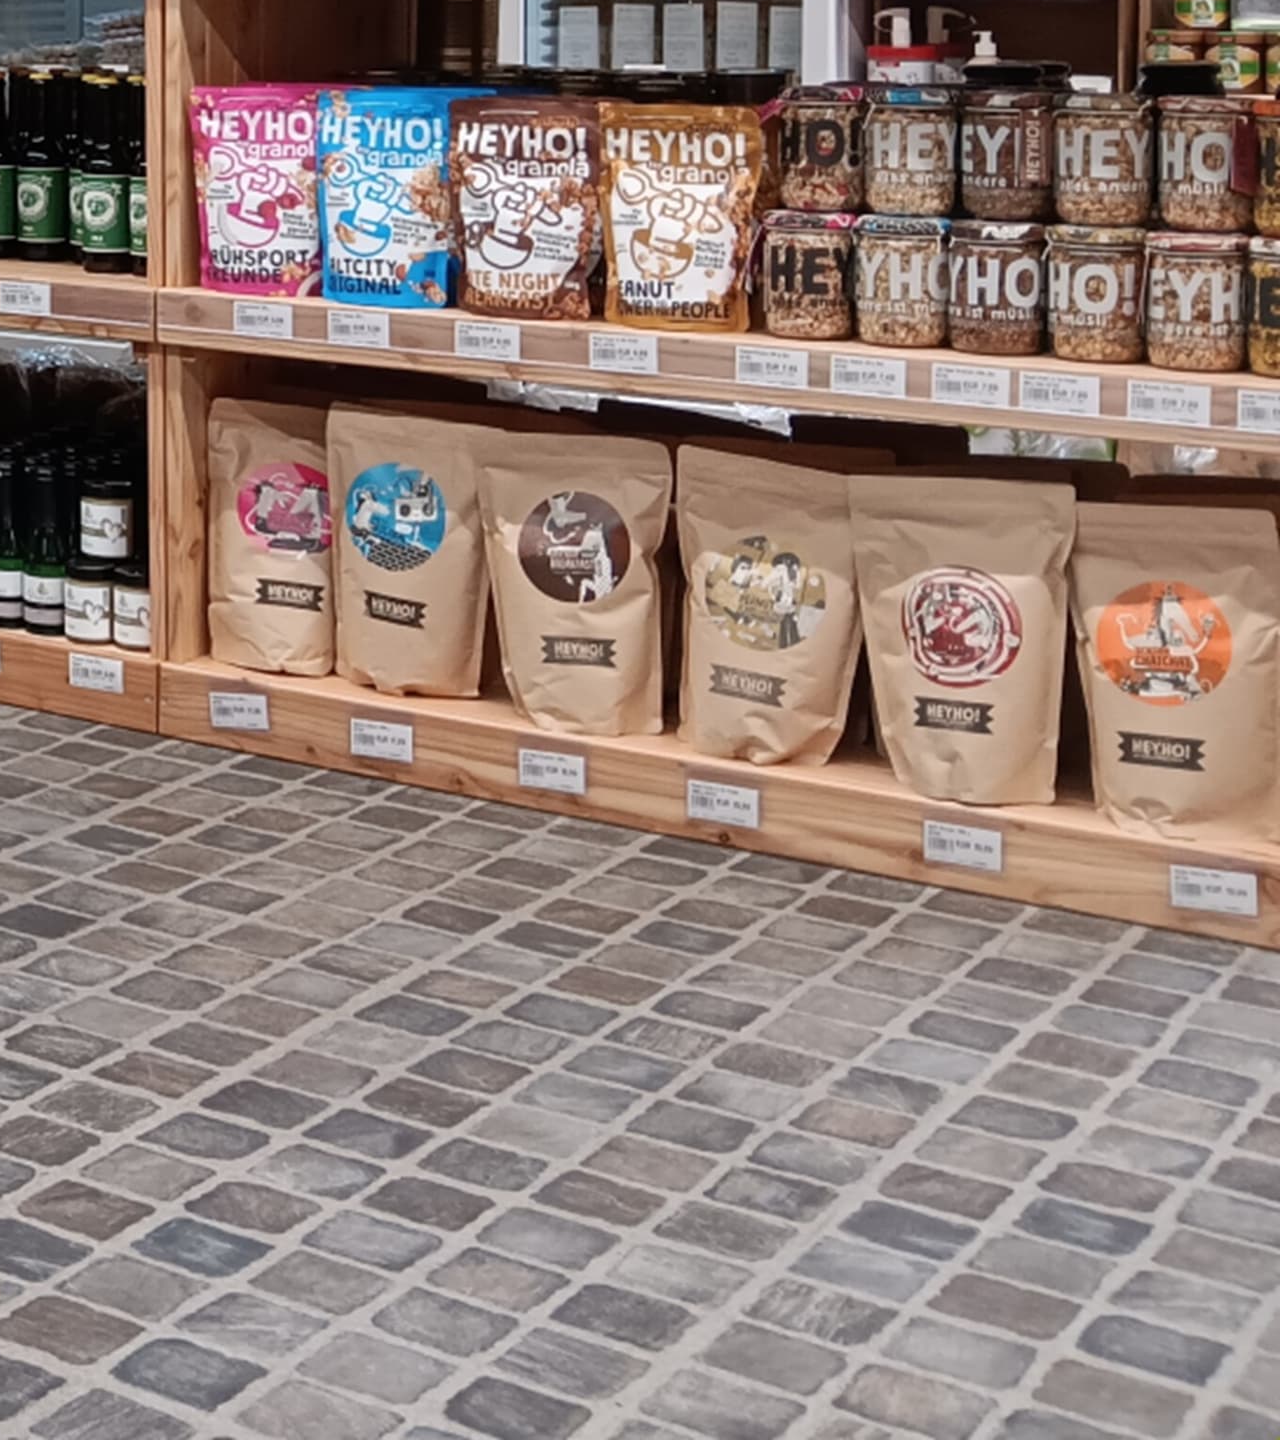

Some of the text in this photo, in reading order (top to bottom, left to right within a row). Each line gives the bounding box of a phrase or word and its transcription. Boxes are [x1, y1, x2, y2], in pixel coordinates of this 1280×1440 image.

[321, 110, 443, 150] HEYHO!
[248, 140, 315, 161] granol
[457, 122, 587, 160] HEYHO!
[606, 128, 747, 167] HEYHO!
[1026, 119, 1040, 180] HEYHO!
[368, 148, 444, 168] granola
[506, 158, 590, 179] granola
[211, 246, 310, 267] RÜHSPORT
[498, 273, 562, 291] NIGHT
[618, 279, 675, 299] EANUT
[671, 301, 733, 320] PEOPLE
[267, 583, 316, 602] HEYHO!
[370, 598, 417, 618] HEYHO!
[553, 640, 604, 659] HEYHO!
[721, 673, 774, 695] HEYHO!
[926, 703, 981, 723] HEYHO!
[1131, 739, 1191, 760] HEYHO!
